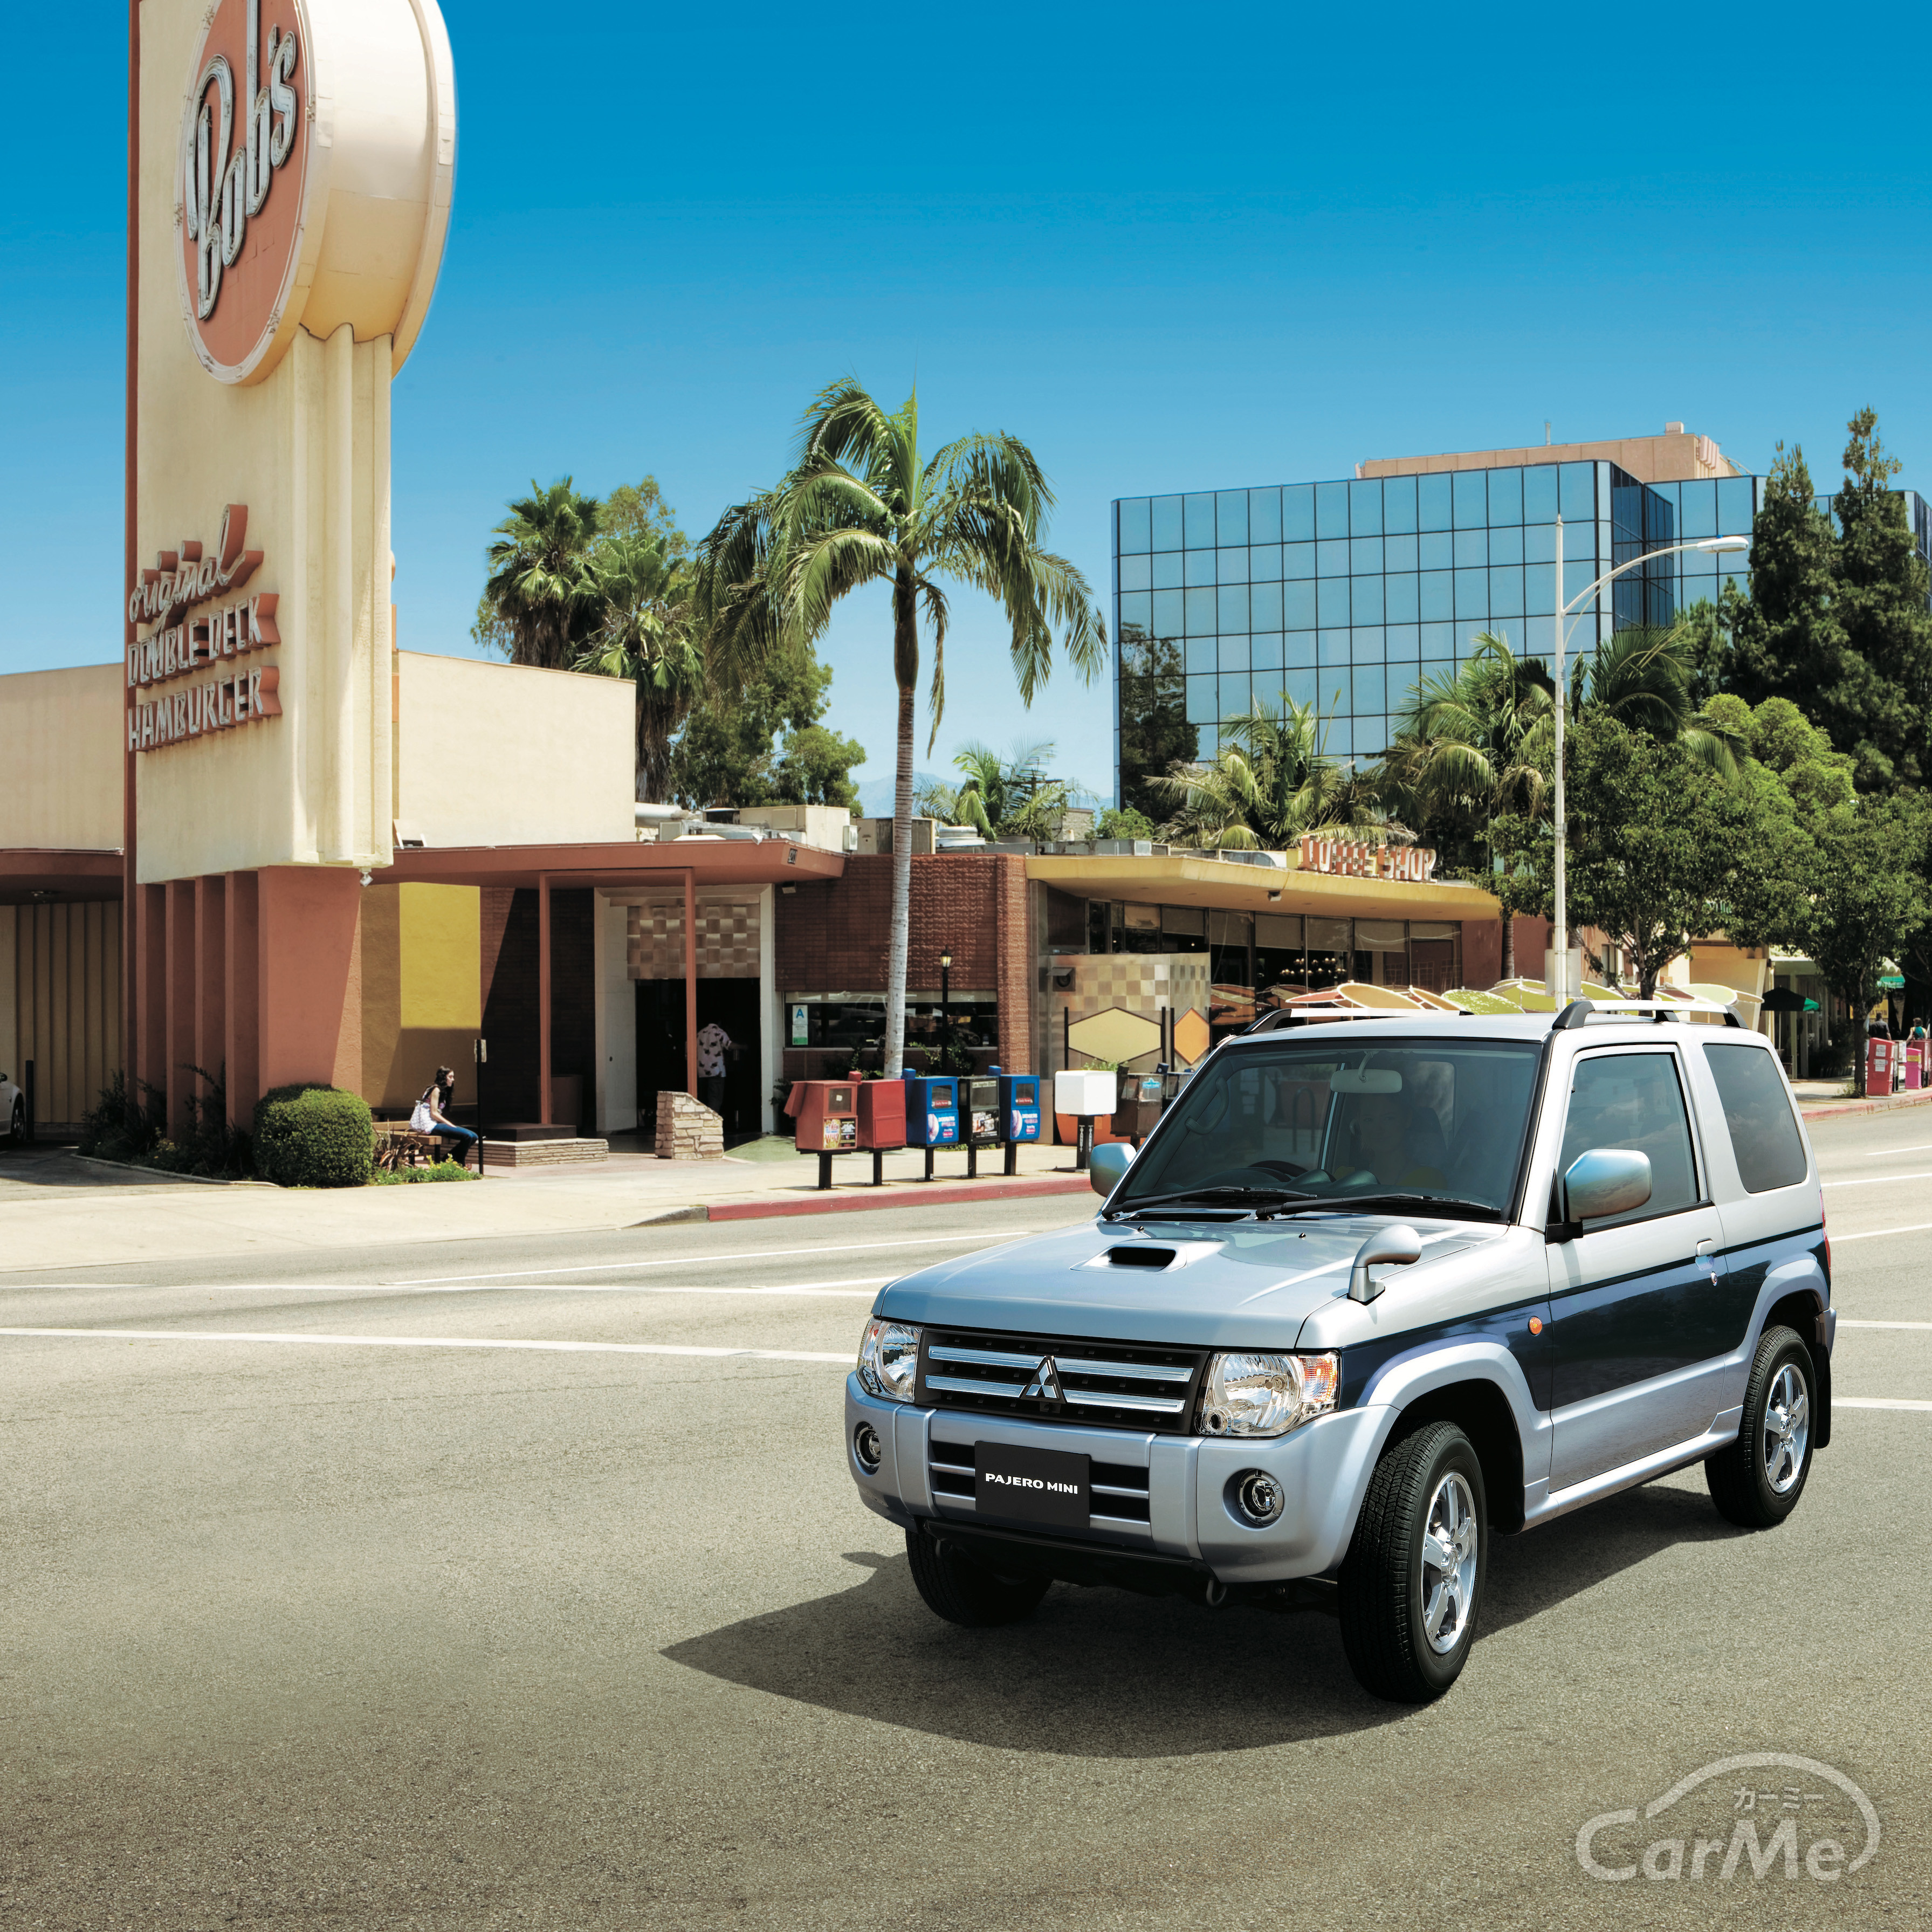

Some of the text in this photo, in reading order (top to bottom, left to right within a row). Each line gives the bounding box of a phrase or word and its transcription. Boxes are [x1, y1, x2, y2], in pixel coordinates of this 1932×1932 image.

[128, 589, 270, 688] DOUBLE DECK
[128, 666, 270, 752] HAMBURGER
[1378, 844, 1438, 883] SHOP
[985, 1473, 1078, 1495] PAJERO MINI
